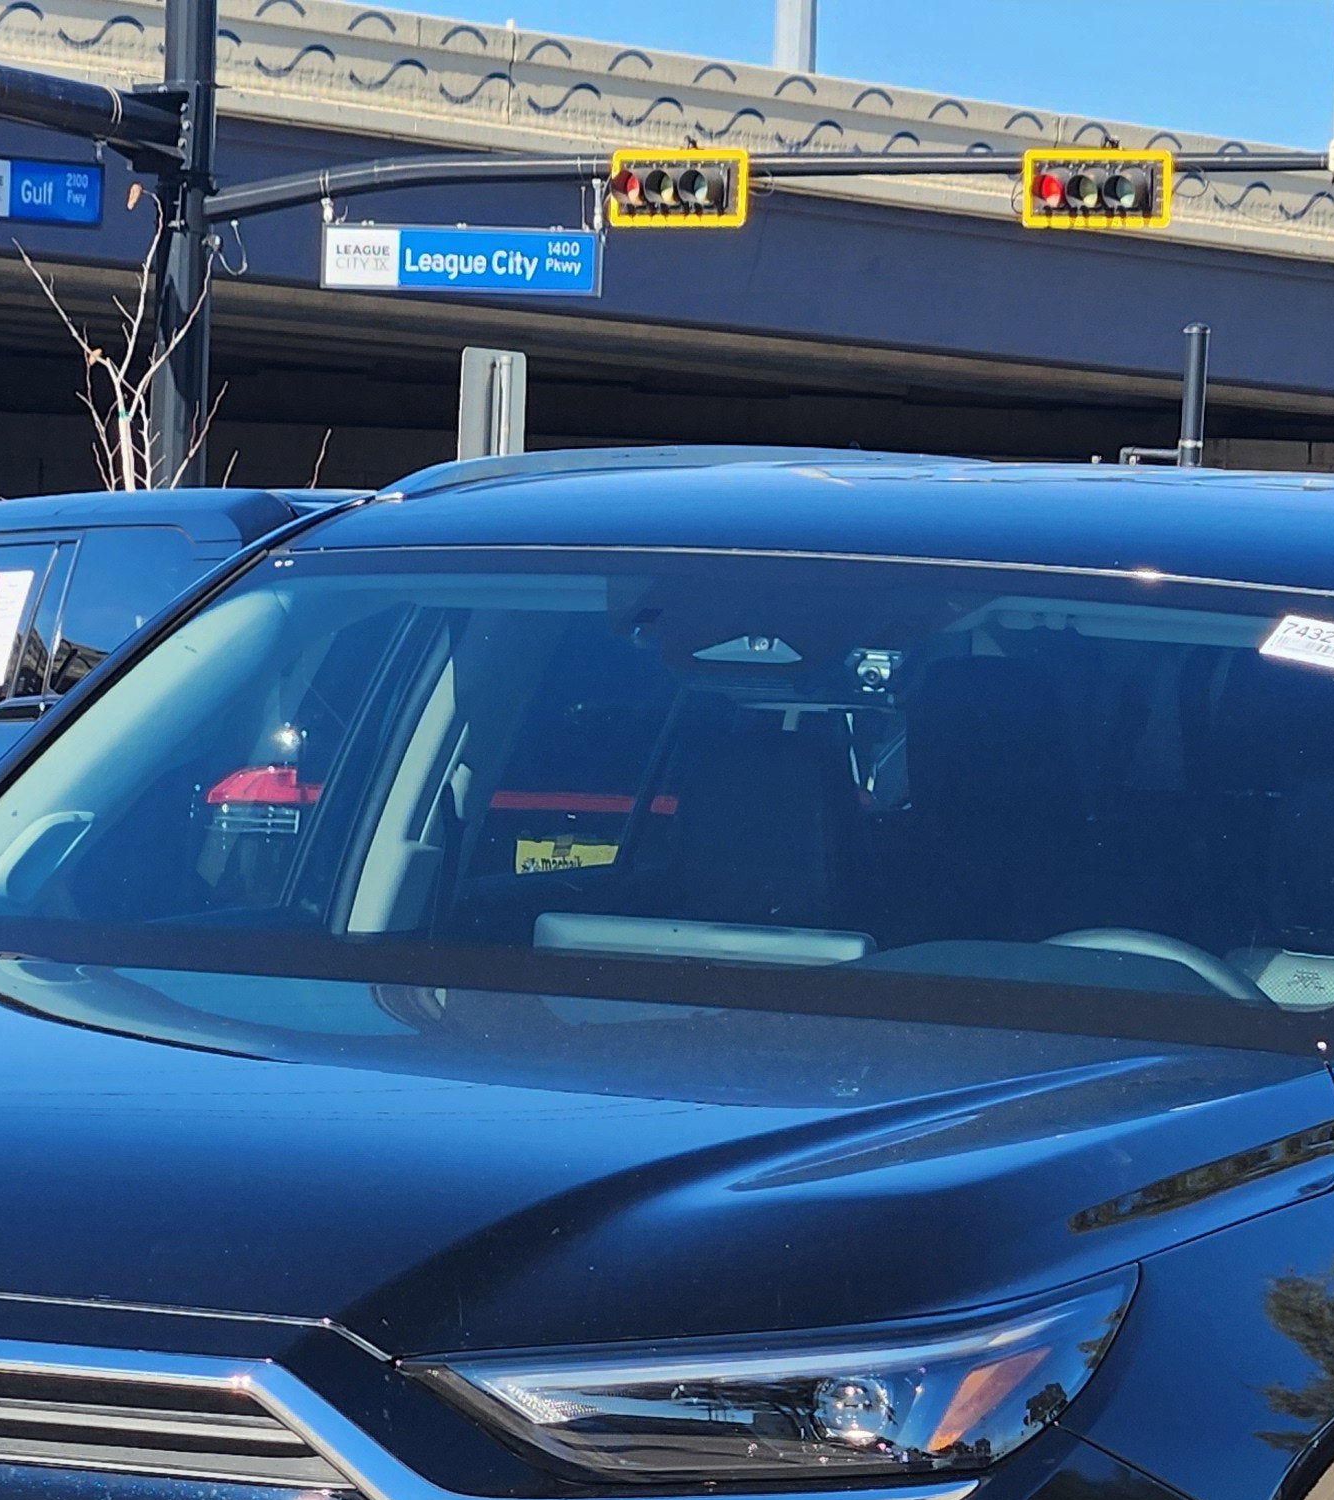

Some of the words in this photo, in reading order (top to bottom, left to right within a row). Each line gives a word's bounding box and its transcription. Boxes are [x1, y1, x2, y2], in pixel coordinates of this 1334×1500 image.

[65, 172, 89, 189] 2100
[21, 179, 54, 206] Gulf
[67, 190, 87, 207] Fwy
[335, 244, 390, 257] LEAGUE
[547, 241, 581, 257] 1400
[335, 257, 371, 270] CITY
[404, 247, 488, 281] League
[491, 249, 539, 281] City
[545, 260, 582, 277] Pkwy
